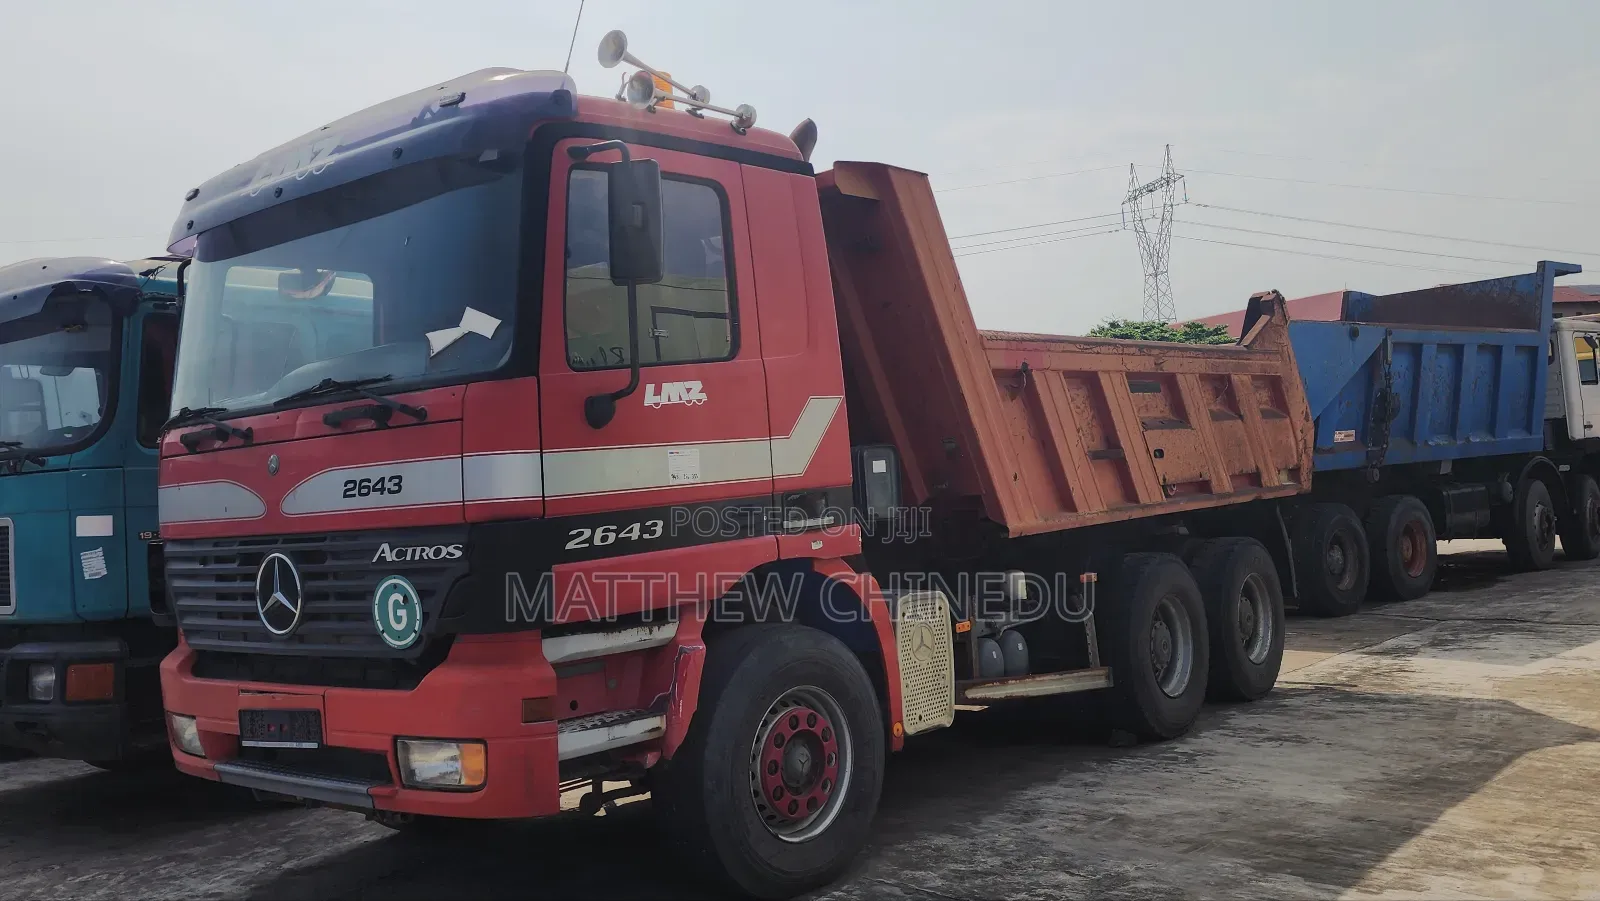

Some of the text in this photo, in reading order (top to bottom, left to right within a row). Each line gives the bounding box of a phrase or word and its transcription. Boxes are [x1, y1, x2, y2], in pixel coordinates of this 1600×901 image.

[644, 381, 708, 409] LMZ
[342, 475, 403, 499] 2643
[564, 519, 664, 550] 2643
[371, 542, 463, 563] ACTROS
[387, 592, 408, 631] G
